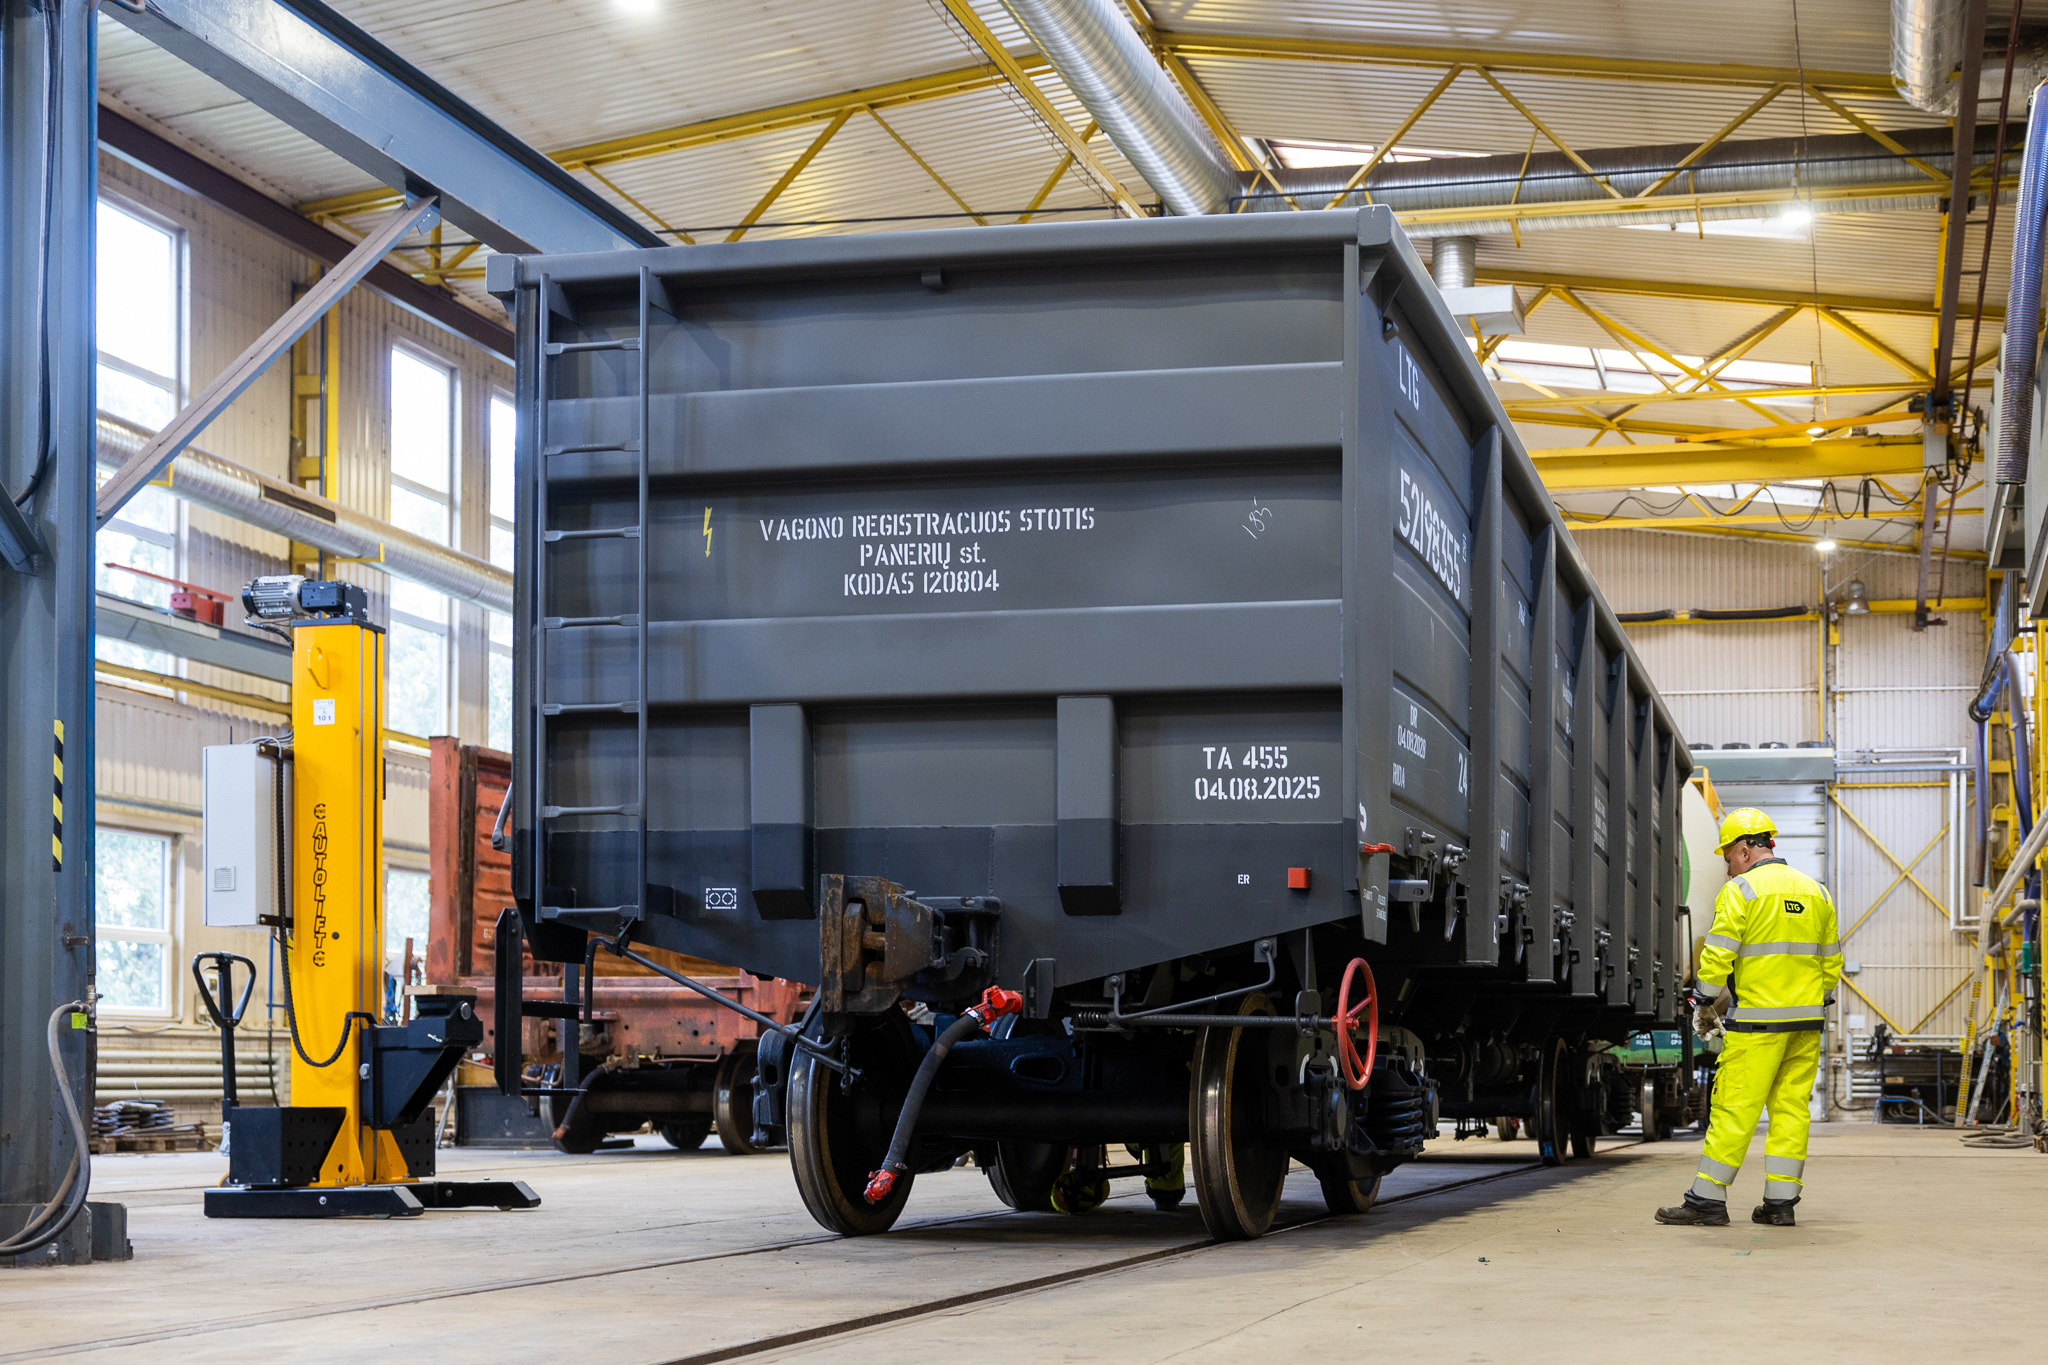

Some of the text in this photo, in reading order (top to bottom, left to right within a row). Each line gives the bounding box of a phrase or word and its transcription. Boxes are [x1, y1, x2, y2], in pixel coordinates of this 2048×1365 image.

[1399, 345, 1419, 410] LTG
[760, 516, 844, 541] VAGONO
[1020, 507, 1095, 531] STOTIS
[1400, 468, 1460, 600] 52198355
[860, 541, 986, 570] PANERIŲ st.
[844, 569, 999, 596] KODAS 120804
[1410, 704, 1418, 729] DR
[1202, 745, 1288, 770] TA 455
[1194, 776, 1320, 800] 04.08.2025
[1458, 752, 1468, 797] 24
[312, 821, 328, 949] AUTOLIFT
[1237, 874, 1250, 885] ER
[1786, 902, 1801, 911] LTG
